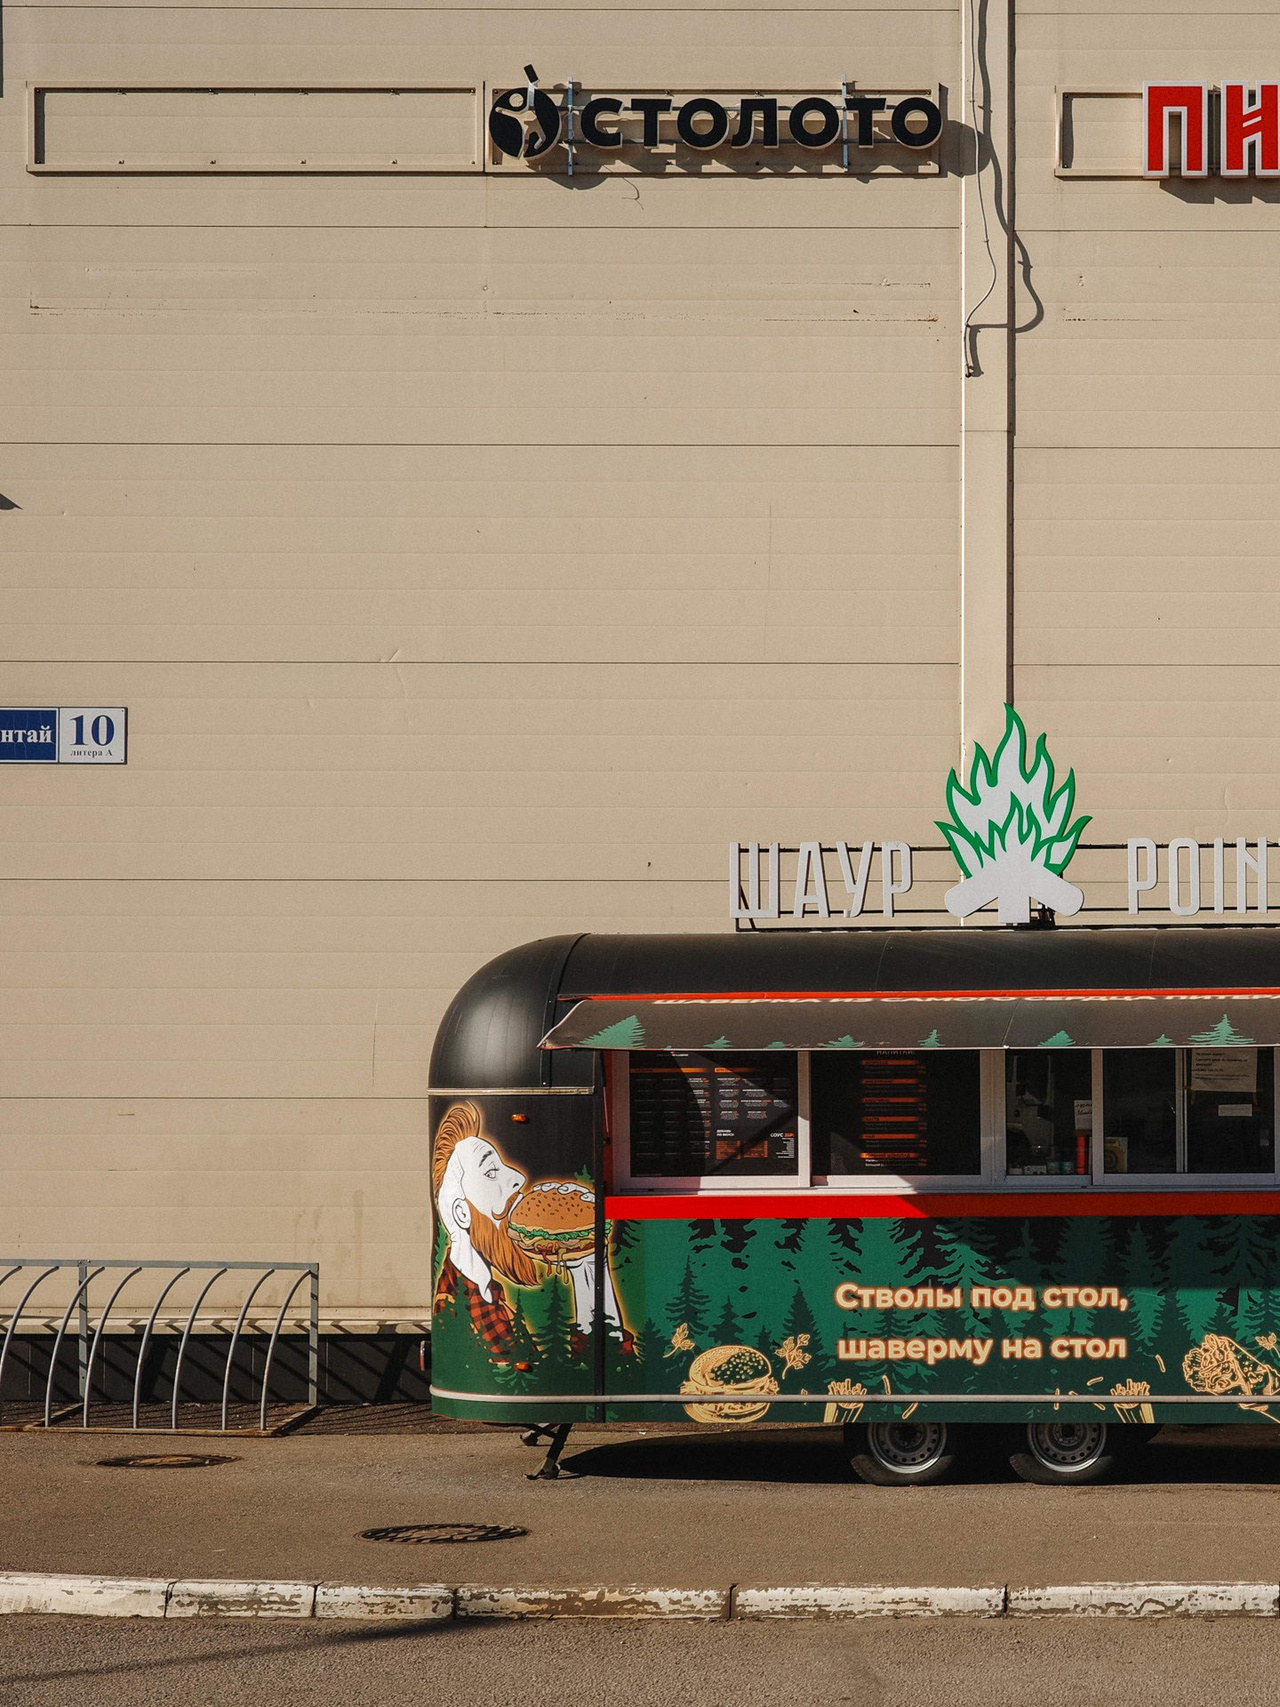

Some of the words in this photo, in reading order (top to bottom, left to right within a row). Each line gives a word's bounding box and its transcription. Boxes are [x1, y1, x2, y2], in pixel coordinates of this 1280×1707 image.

[580, 97, 942, 149] СТОЛОТО
[69, 714, 115, 746] 10
[70, 749, 103, 758] литера
[105, 749, 113, 757] А
[729, 841, 912, 919] ШАУР
[835, 1283, 962, 1309] Стволы
[971, 1286, 1035, 1311] под
[1043, 1286, 1128, 1311] стол,
[837, 1336, 994, 1365] шаверму
[1001, 1337, 1043, 1359] на
[1051, 1337, 1127, 1359] стол
